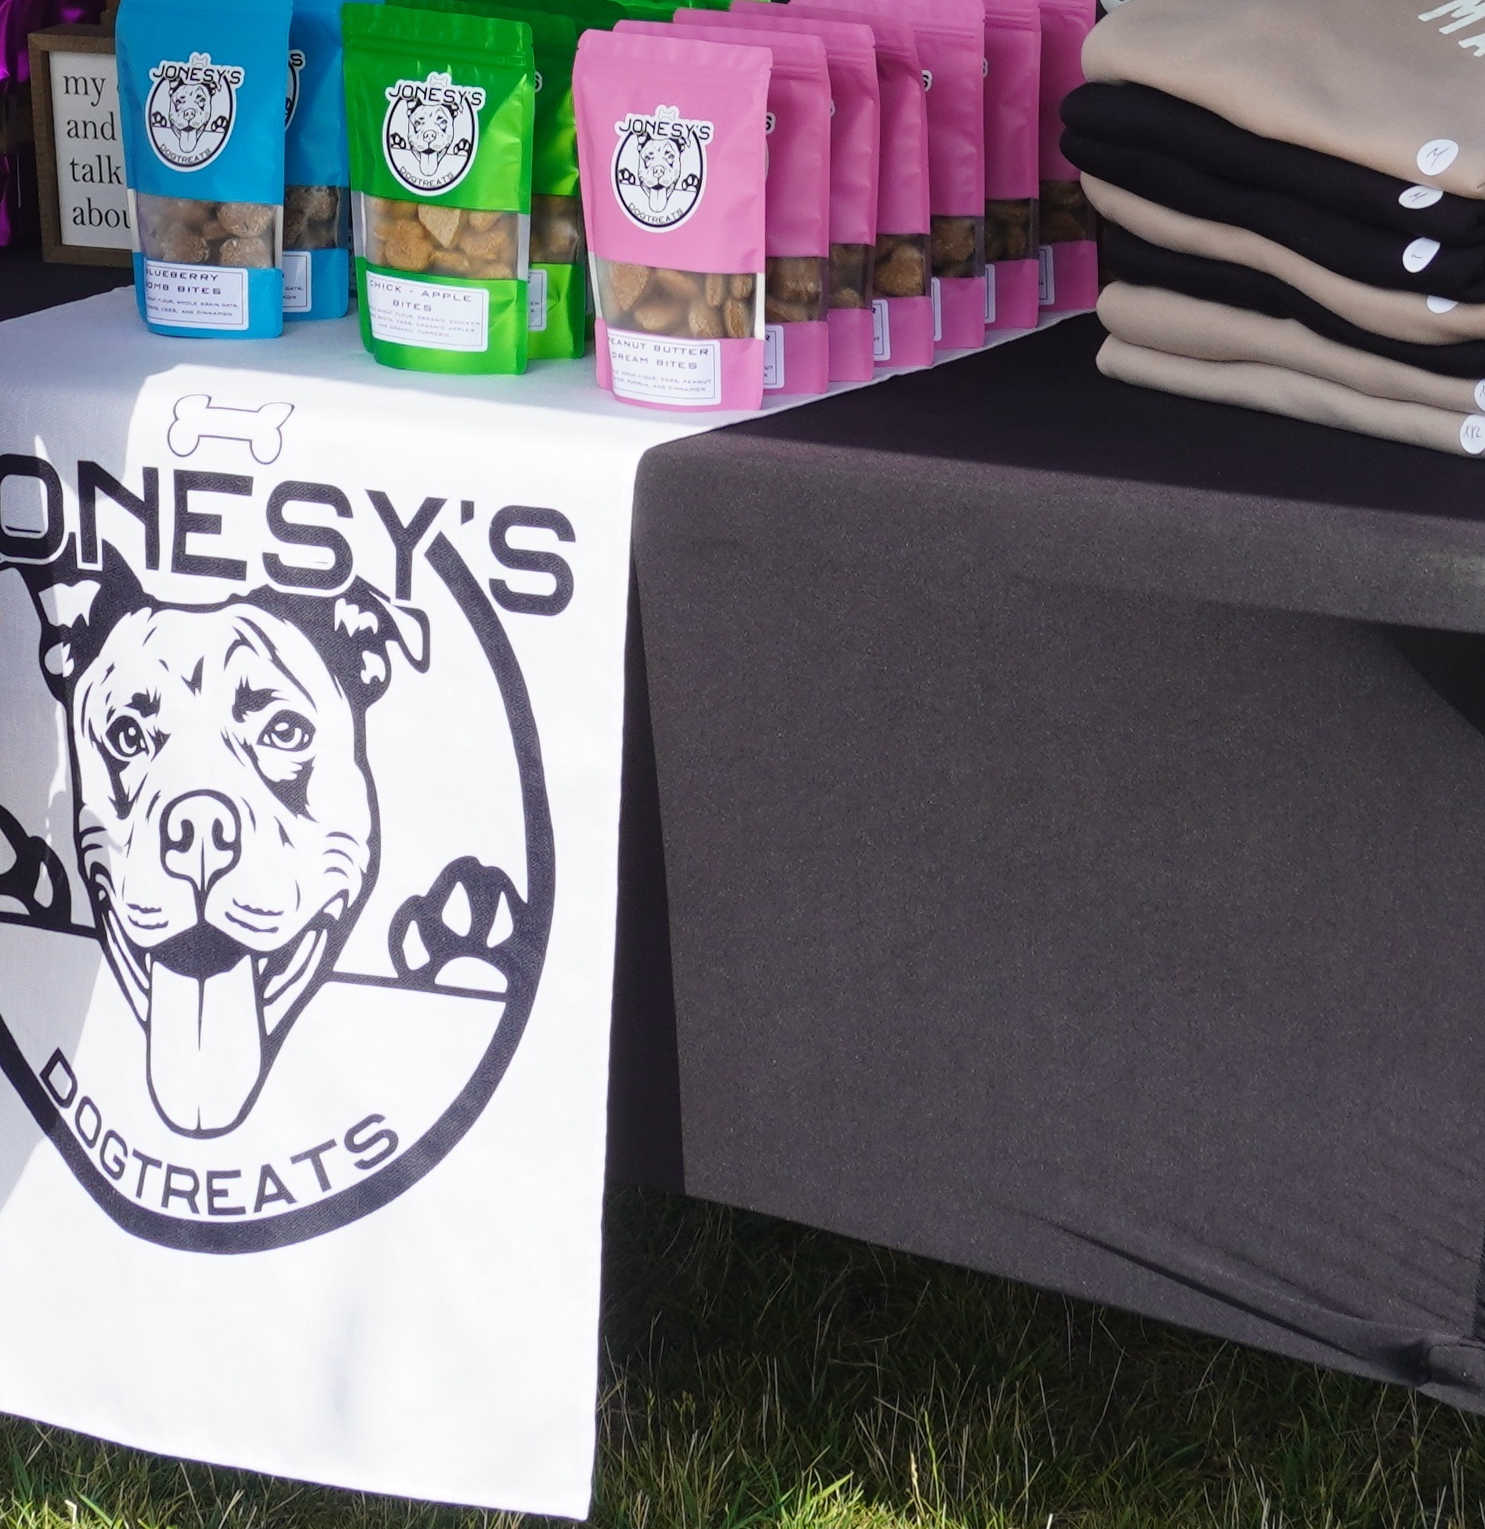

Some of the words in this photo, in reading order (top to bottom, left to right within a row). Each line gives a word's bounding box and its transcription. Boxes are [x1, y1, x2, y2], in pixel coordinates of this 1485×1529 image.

[152, 64, 242, 85] JONESY'S
[62, 74, 107, 107] my
[388, 84, 483, 106] JONESY'S
[66, 110, 117, 141] and
[619, 118, 711, 141] JONESY'S
[69, 154, 123, 185] talk
[146, 281, 169, 291] OMB
[177, 285, 221, 295] BITES
[369, 279, 403, 294] CHICK
[421, 290, 473, 303] APPLE
[392, 299, 432, 312] BITES
[611, 352, 648, 365] DREAM
[656, 359, 698, 370] BITES
[653, 345, 709, 356] BUTTER
[38, 1046, 399, 1216] DOGTREATS
